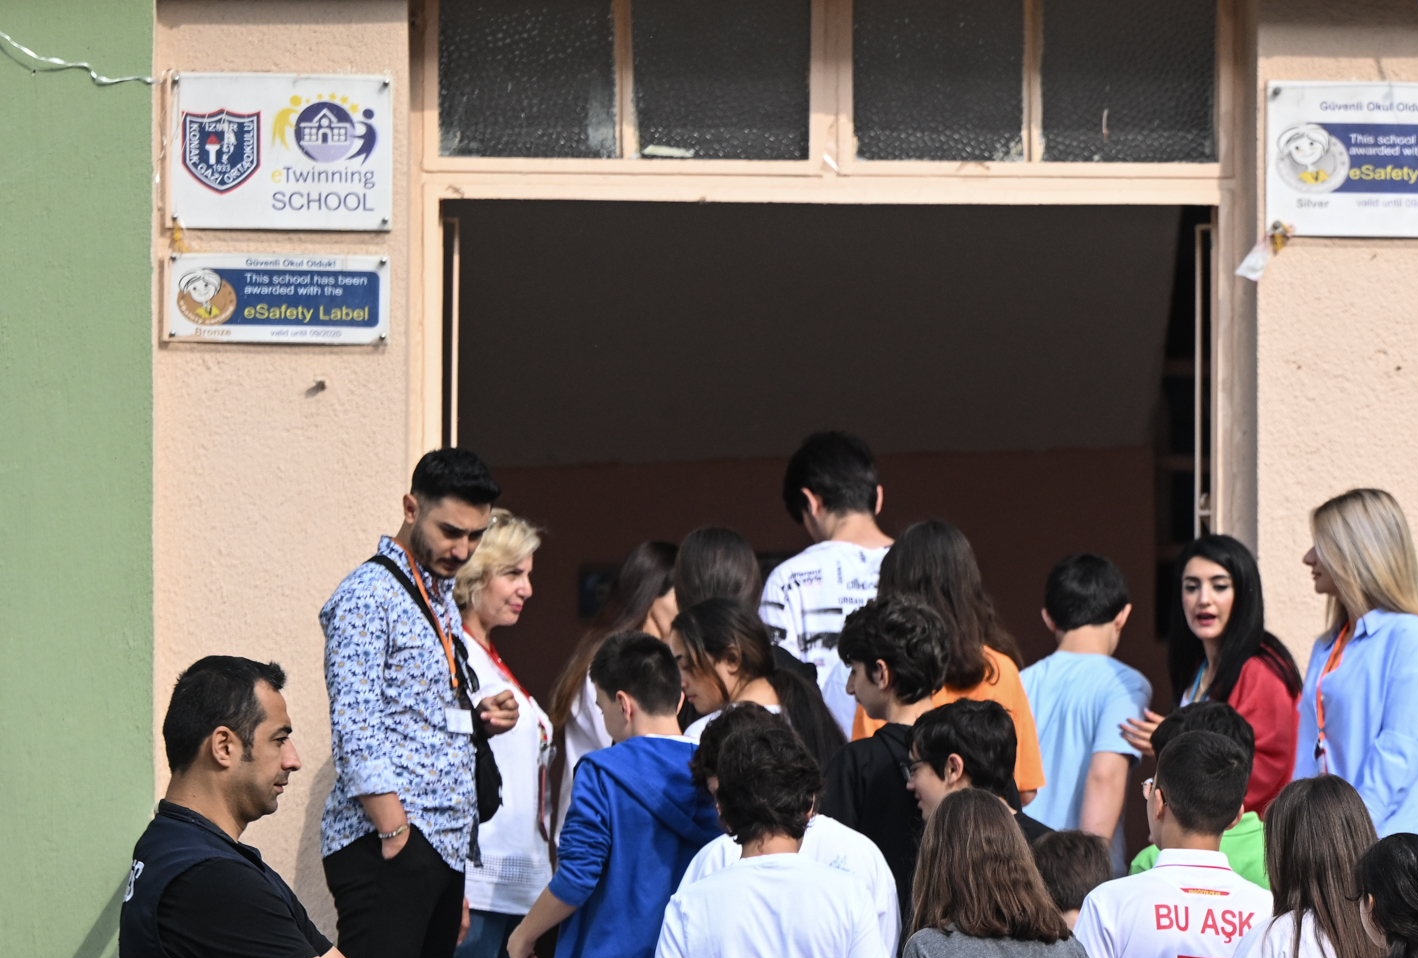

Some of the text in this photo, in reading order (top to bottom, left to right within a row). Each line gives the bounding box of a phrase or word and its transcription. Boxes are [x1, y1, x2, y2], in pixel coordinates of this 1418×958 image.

[1319, 101, 1364, 112] Güvenli
[1366, 101, 1394, 112] Okul
[190, 122, 200, 164] KONAK
[1349, 134, 1375, 144] This
[1376, 134, 1416, 145] school
[1349, 145, 1400, 156] awarded
[271, 167, 375, 190] eTwinning
[271, 191, 375, 212] SCHOOL
[1296, 198, 1329, 209] Silver
[282, 259, 304, 269] Okul
[306, 259, 337, 269] Olduk!
[244, 273, 368, 286] This school has been
[243, 285, 343, 297] awarded with the
[243, 303, 369, 323] eSafety Label
[194, 326, 232, 337] Bronze
[1154, 904, 1189, 932] BU
